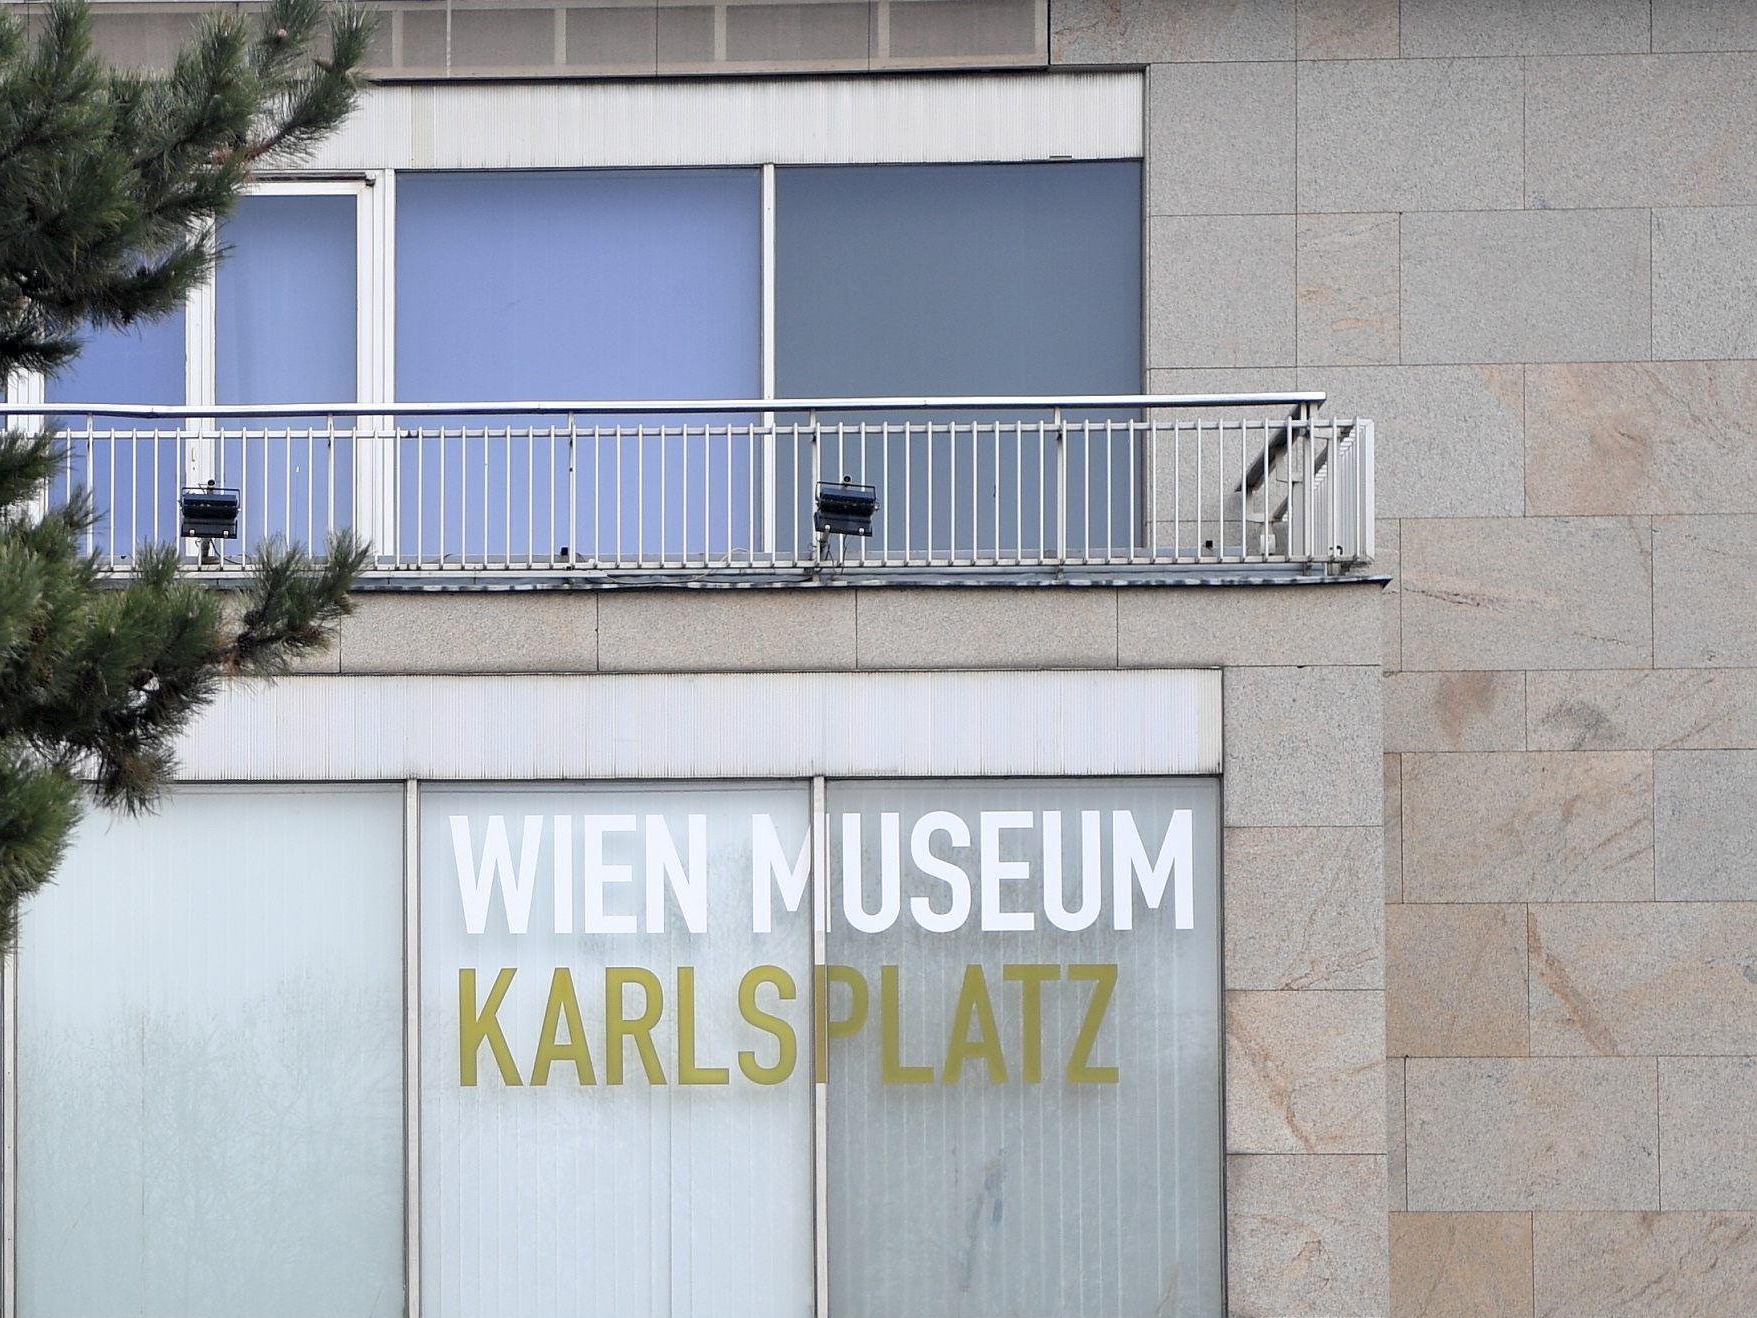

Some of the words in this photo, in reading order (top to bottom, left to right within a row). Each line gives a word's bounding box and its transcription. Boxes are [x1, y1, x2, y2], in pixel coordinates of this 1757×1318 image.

[449, 813, 707, 935] WIEN
[752, 808, 1196, 934] MUSEUM
[458, 963, 1120, 1088] KARLSPLATZ
